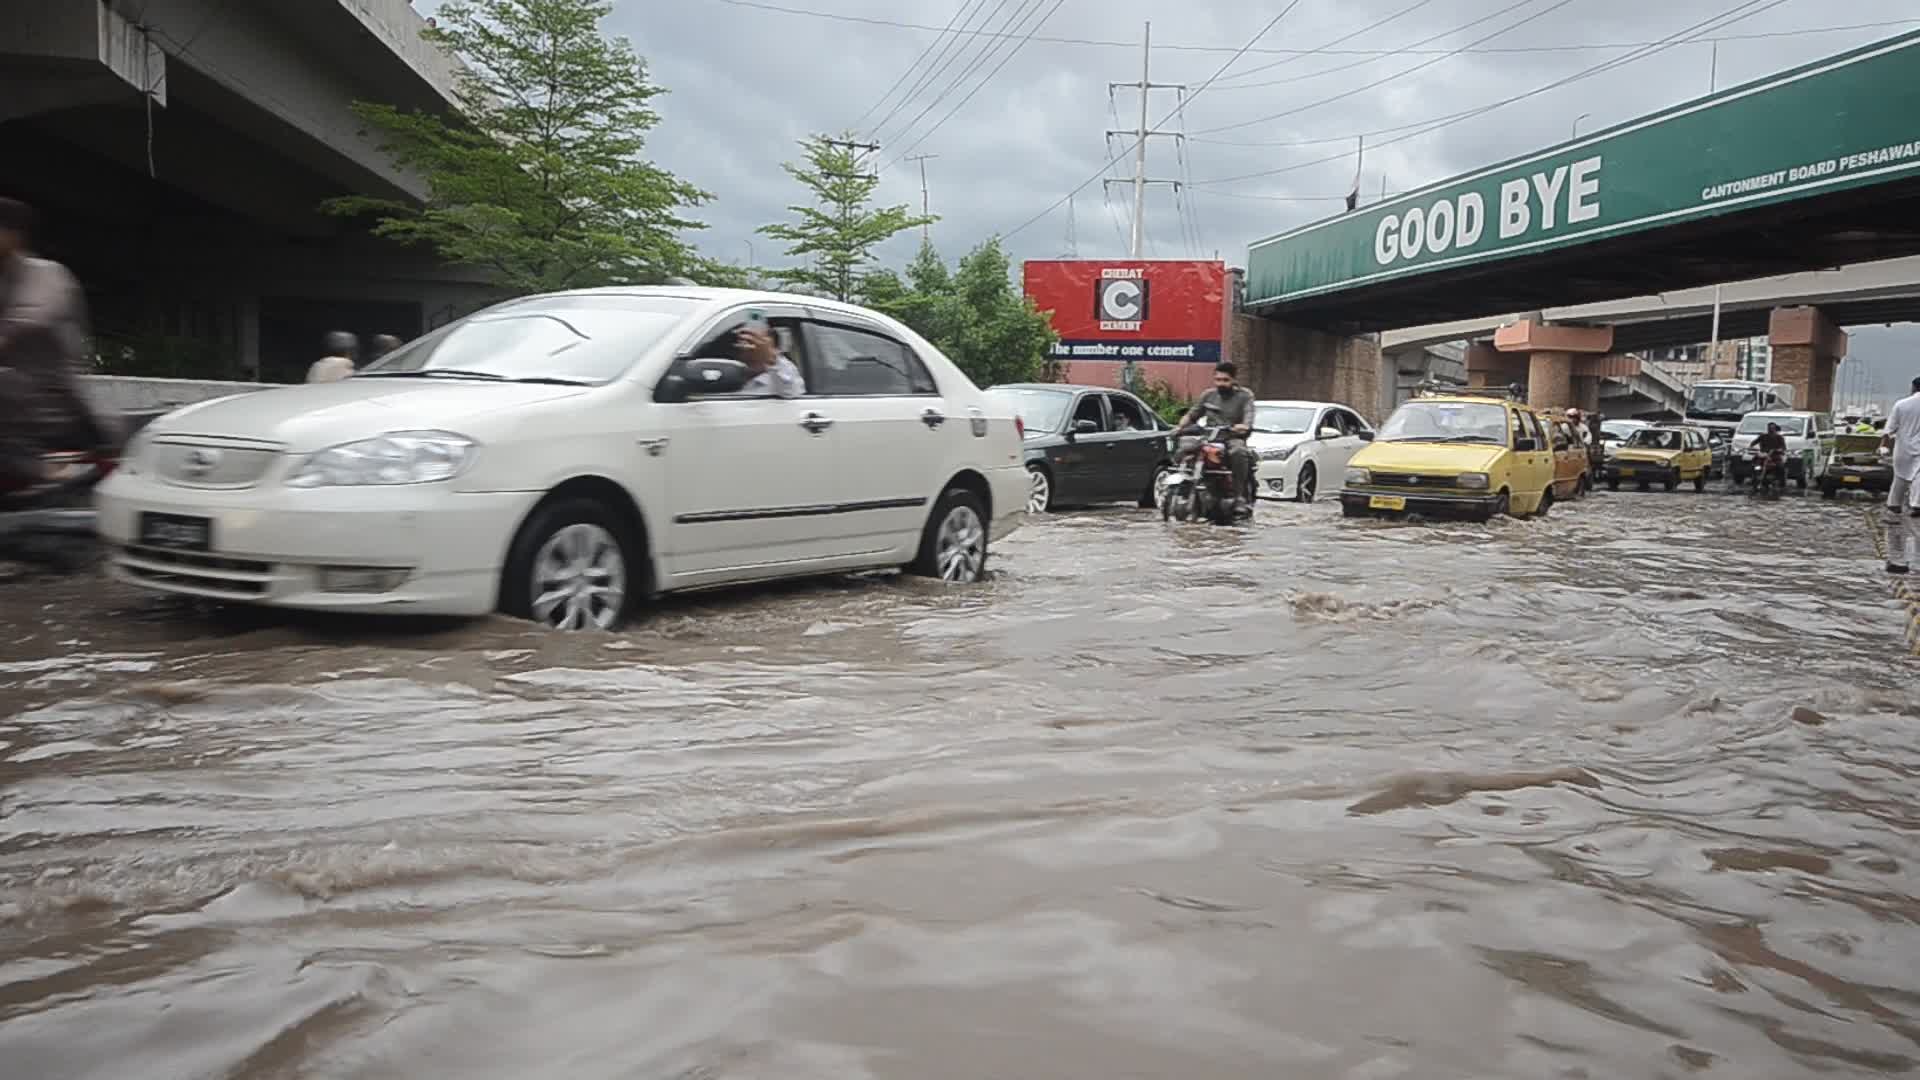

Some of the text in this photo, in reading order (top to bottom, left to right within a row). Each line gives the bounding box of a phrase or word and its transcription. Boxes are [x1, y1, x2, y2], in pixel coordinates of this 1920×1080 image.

[1702, 170, 1787, 200] CANTONMENT
[1789, 160, 1836, 182] BOARD
[1375, 155, 1602, 265] GOOD BYE
[1103, 280, 1141, 320] C
[1072, 343, 1119, 355] number
[1121, 345, 1144, 356] one
[1147, 344, 1194, 356] cement
